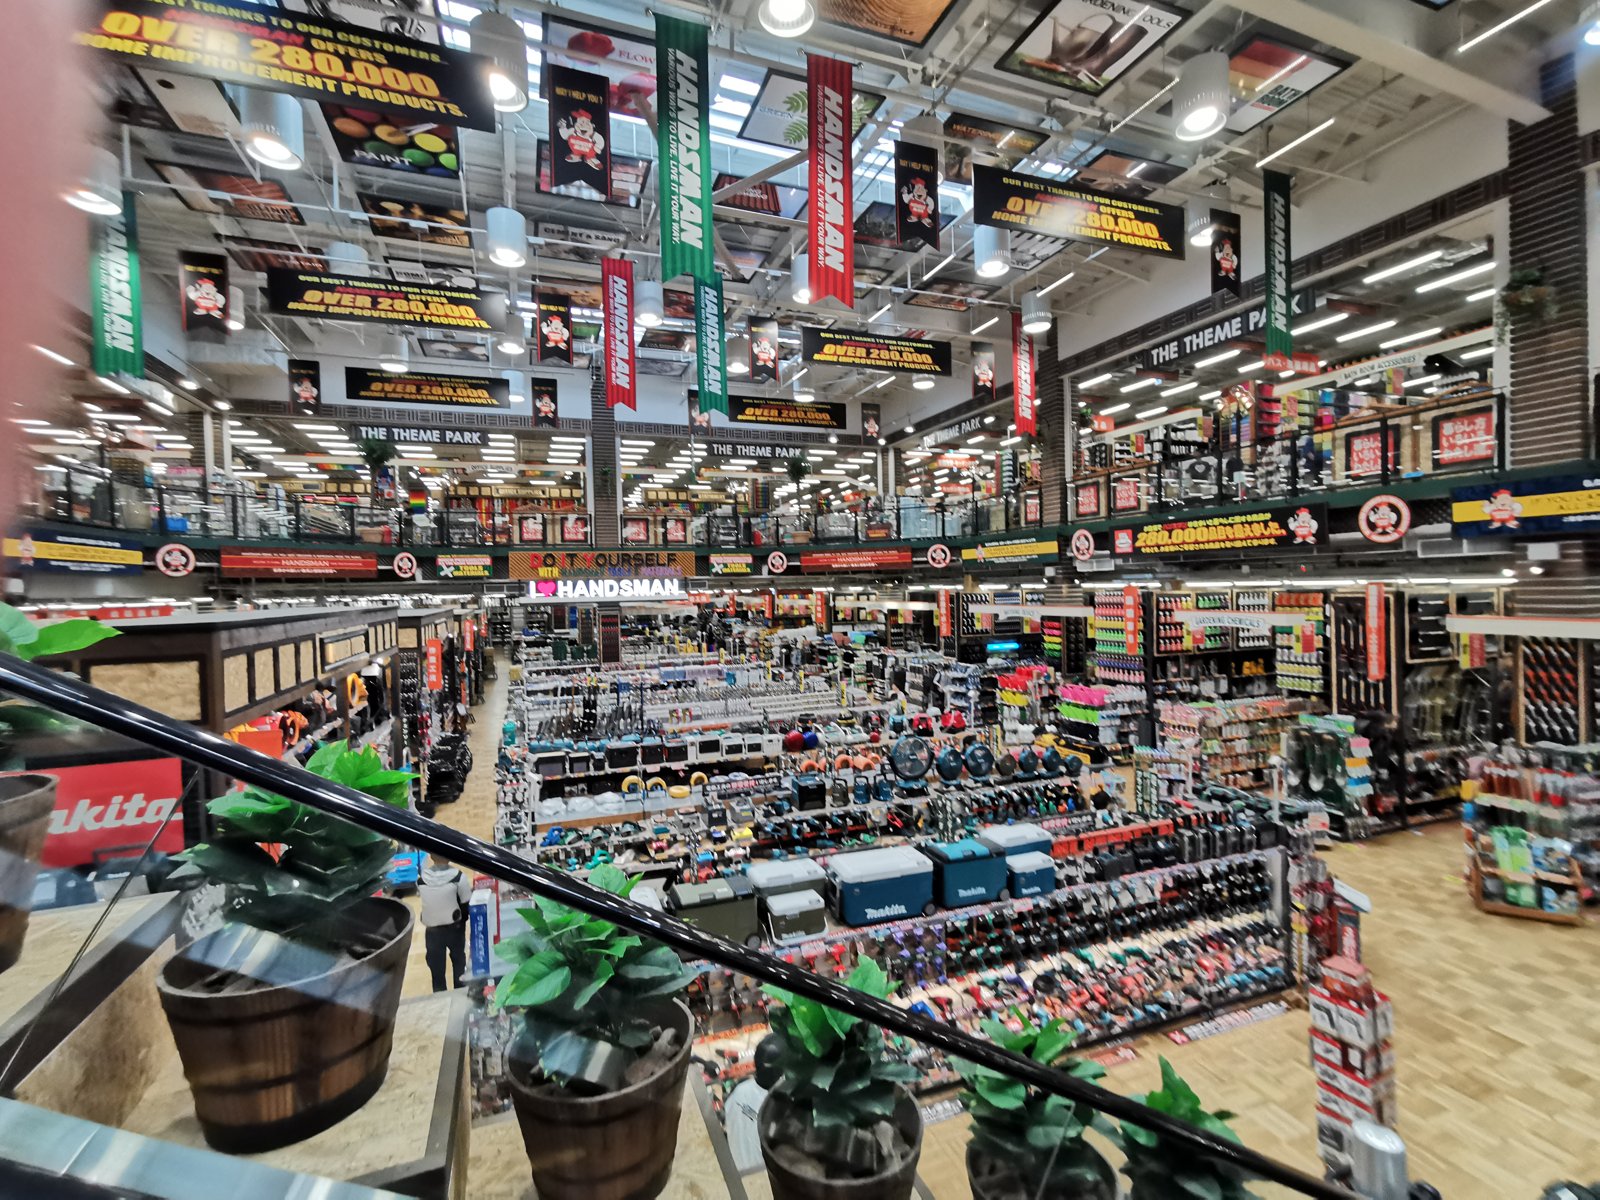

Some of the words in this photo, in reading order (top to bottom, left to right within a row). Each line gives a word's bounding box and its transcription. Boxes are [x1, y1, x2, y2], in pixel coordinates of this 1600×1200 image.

[191, 0, 266, 24] THANKS
[269, 15, 294, 30] TO
[296, 22, 333, 42] OUR
[101, 11, 240, 57] OVER
[310, 38, 388, 65] OFFERS
[150, 44, 338, 94] IMPROVEMENT
[342, 82, 468, 119] PRODUCTS.
[669, 119, 679, 134] TO
[353, 149, 413, 166] PAINT
[676, 48, 704, 250] HANDSMAN
[671, 159, 680, 183] LIVE
[824, 86, 845, 273] HANDSMAN
[671, 184, 680, 196] IT
[1002, 176, 1021, 188] OUR
[1023, 181, 1045, 193] BEST
[1046, 186, 1080, 199] THANKS
[1081, 192, 1093, 202] TO
[1093, 195, 1111, 206] OUR
[671, 197, 681, 221] YOUR
[992, 211, 1028, 225] HOME
[1100, 205, 1136, 219] OFFERS
[1274, 192, 1287, 334] HANDSMAN
[298, 274, 321, 284] OUR
[321, 277, 346, 287] BEST
[348, 279, 386, 291] THANKS
[387, 284, 400, 292] TO
[400, 285, 421, 294] OUR
[303, 289, 372, 308] OVER
[408, 293, 449, 304] OFFERS
[287, 302, 328, 313] HOME
[328, 305, 422, 322] IMPROVEMENT
[613, 275, 630, 390] HANDSMAN
[704, 286, 722, 396] HANDSMAN
[1151, 341, 1179, 367] THE
[1184, 317, 1242, 354] THEME
[813, 353, 838, 362] HOME
[838, 355, 898, 368] IMPROVEMENT
[823, 344, 868, 358] OVER
[370, 381, 418, 394] OVER
[745, 407, 780, 417] OVER
[360, 426, 387, 440] THE
[392, 428, 440, 442] THEME
[445, 430, 481, 445] PARK
[936, 424, 960, 443] THEME
[961, 416, 981, 434] PARK
[712, 442, 733, 456] THE
[736, 445, 772, 458] THEME
[774, 448, 802, 458] PARK
[530, 552, 556, 569] DO
[560, 553, 579, 568] IT
[583, 552, 678, 568] YOURSELF
[538, 566, 560, 578] WITH
[557, 578, 680, 598] HANDSMAN
[47, 793, 184, 835] akita
